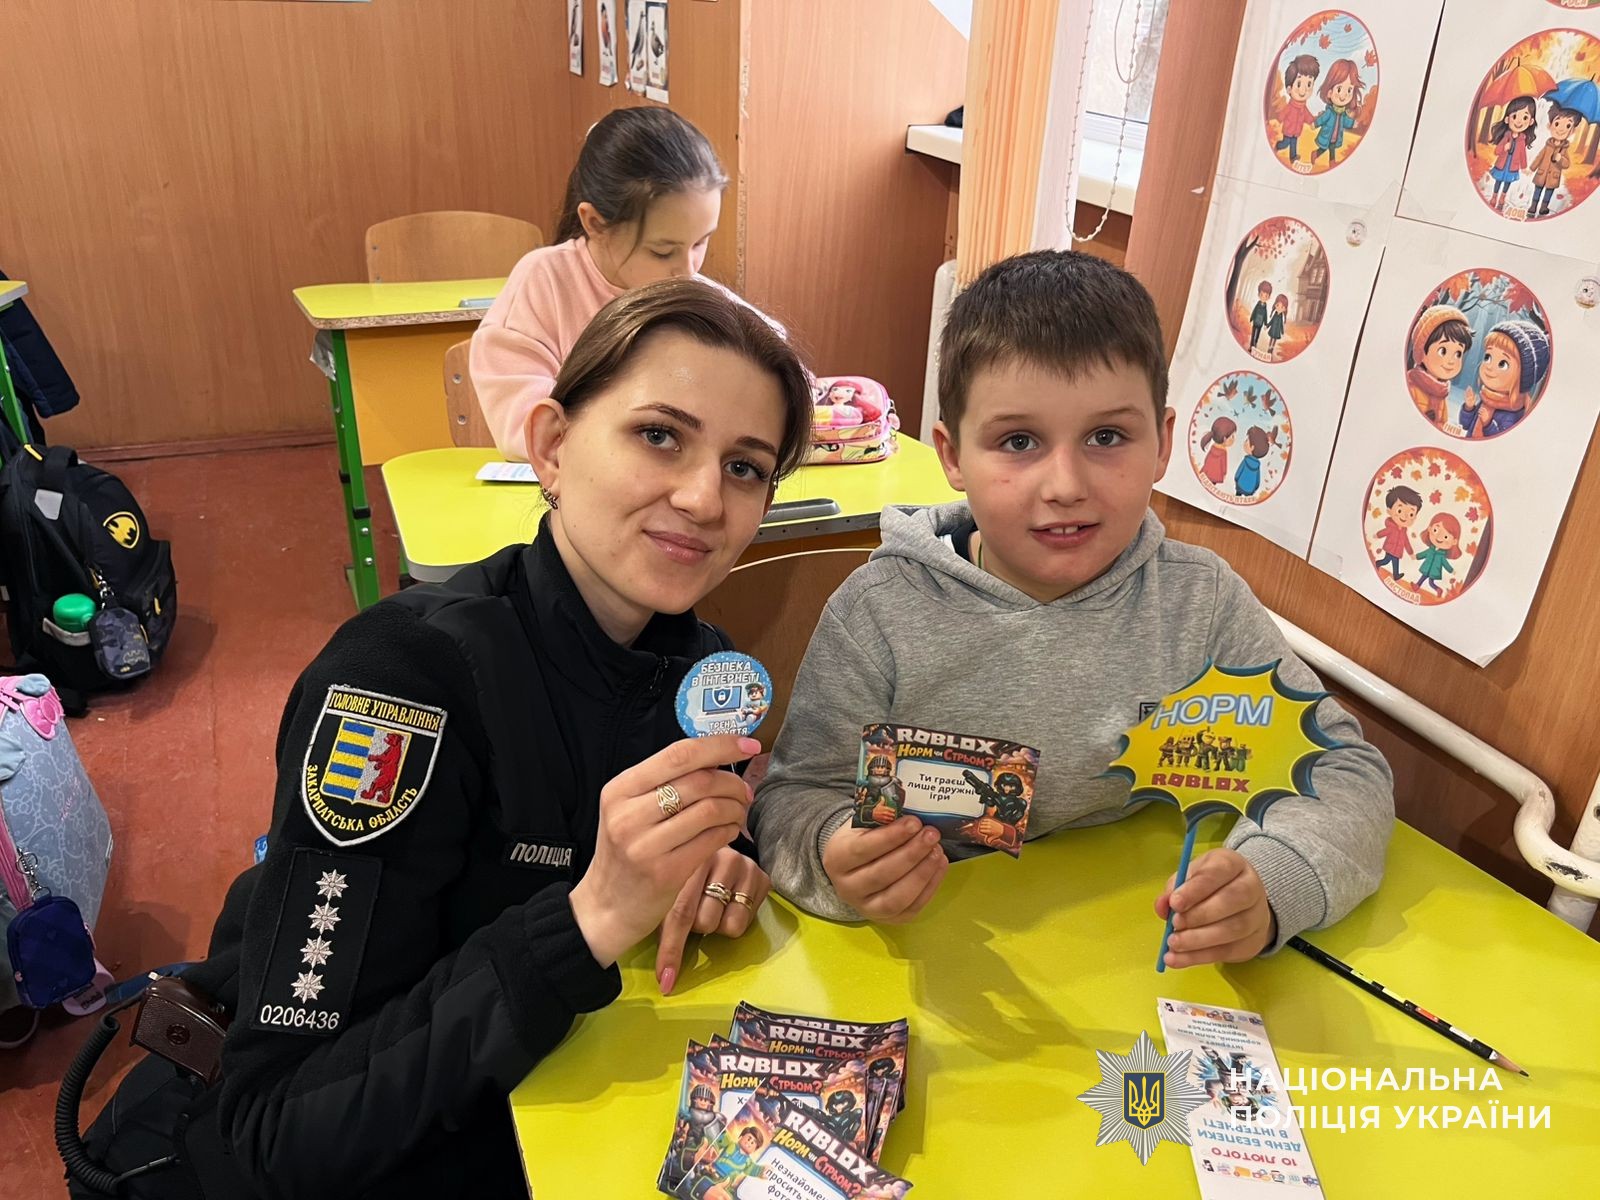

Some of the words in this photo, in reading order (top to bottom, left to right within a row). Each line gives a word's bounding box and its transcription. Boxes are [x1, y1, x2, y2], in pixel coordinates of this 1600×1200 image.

[1385, 577, 1420, 602] ЛИСТОПАД
[701, 661, 752, 674] БЕЗПЕКА
[691, 677, 700, 687] В
[328, 692, 372, 715] ГОЛОВНЕ
[370, 698, 442, 731] УПРАВЛІННЯ
[1151, 694, 1274, 729] НОРМ
[709, 719, 737, 730] ТРЕНД
[897, 728, 996, 756] ROBLOX
[907, 781, 936, 791] лише
[938, 785, 975, 797] дружні
[919, 773, 932, 782] Ти
[934, 776, 965, 787] граєш
[1151, 773, 1251, 793] ROBLOX
[306, 764, 365, 832] ЗАКАРПАТСЬКА
[368, 787, 418, 830] ОБЛАСТЬ
[929, 792, 951, 802] ігри
[510, 842, 573, 868] ПОЛІЦІЯ
[260, 1004, 340, 1030] 0206436
[769, 1025, 867, 1050] ROBLOX
[720, 1055, 824, 1079] ROBLOX
[1197, 1128, 1261, 1147] БЕЗПЕКИ
[1279, 1129, 1289, 1139] В
[784, 1110, 878, 1187] ROBLOX
[1211, 1147, 1276, 1164] ЛЮТОГО
[1264, 1140, 1301, 1152] ДЕНЬ
[1282, 1157, 1297, 1167] 10
[765, 1169, 803, 1200] просить
